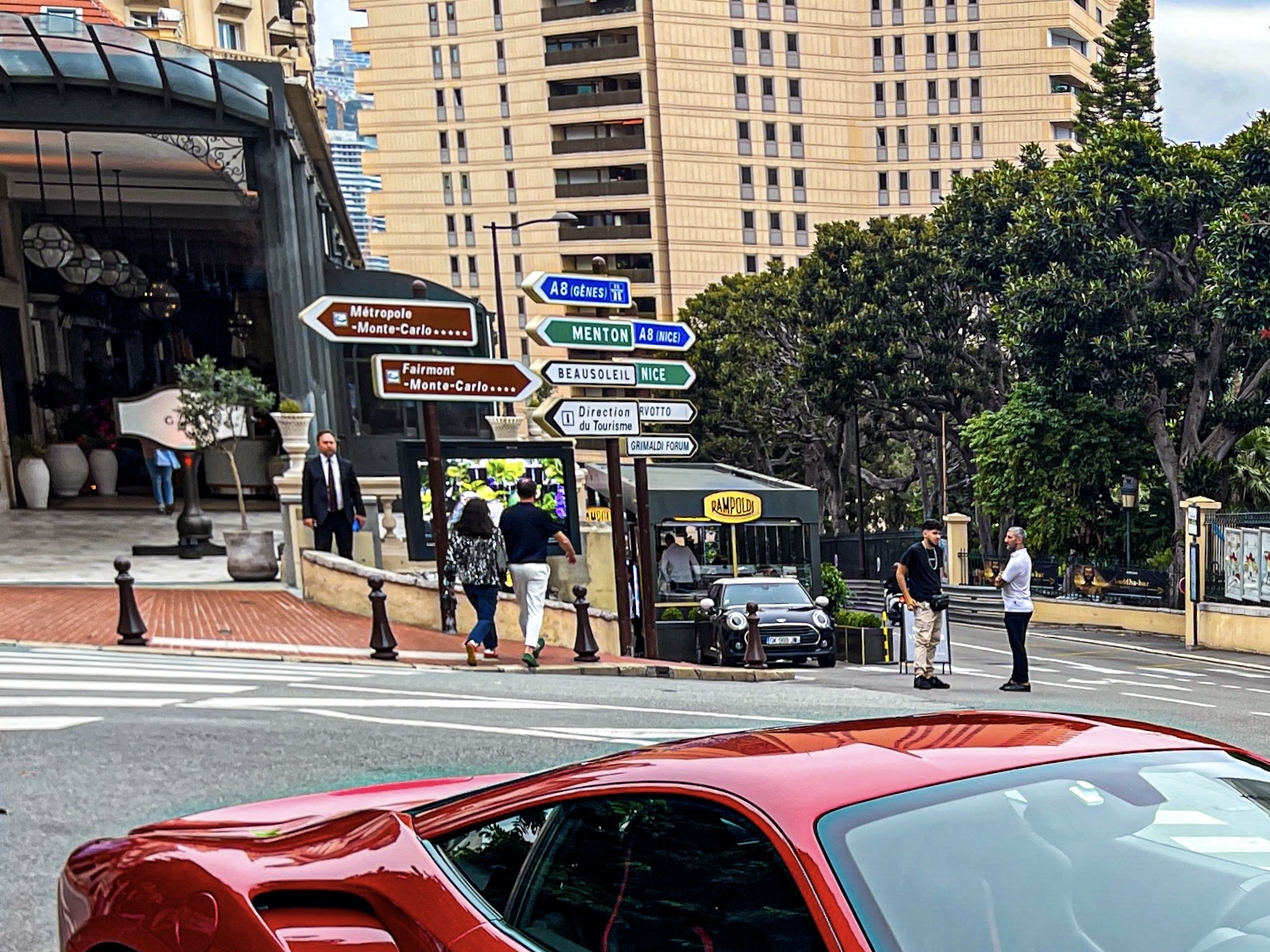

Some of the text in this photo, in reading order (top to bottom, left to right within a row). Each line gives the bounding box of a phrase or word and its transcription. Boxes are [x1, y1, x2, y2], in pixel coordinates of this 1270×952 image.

[550, 281, 608, 299] A8 (GÊNES)
[350, 305, 412, 321] Métropole
[572, 326, 629, 343] MENTON
[639, 327, 681, 344] A8 (NICE)
[402, 363, 455, 376] Fairmont
[558, 367, 630, 381] BEAUSOLEIL
[641, 367, 666, 382] NICE
[579, 406, 630, 418] Direction
[640, 406, 672, 417] RVOTTO
[579, 420, 633, 432] du Tourisme
[631, 440, 690, 451] GRIMALDI FORUM
[711, 496, 754, 514] RAMPOLDI
